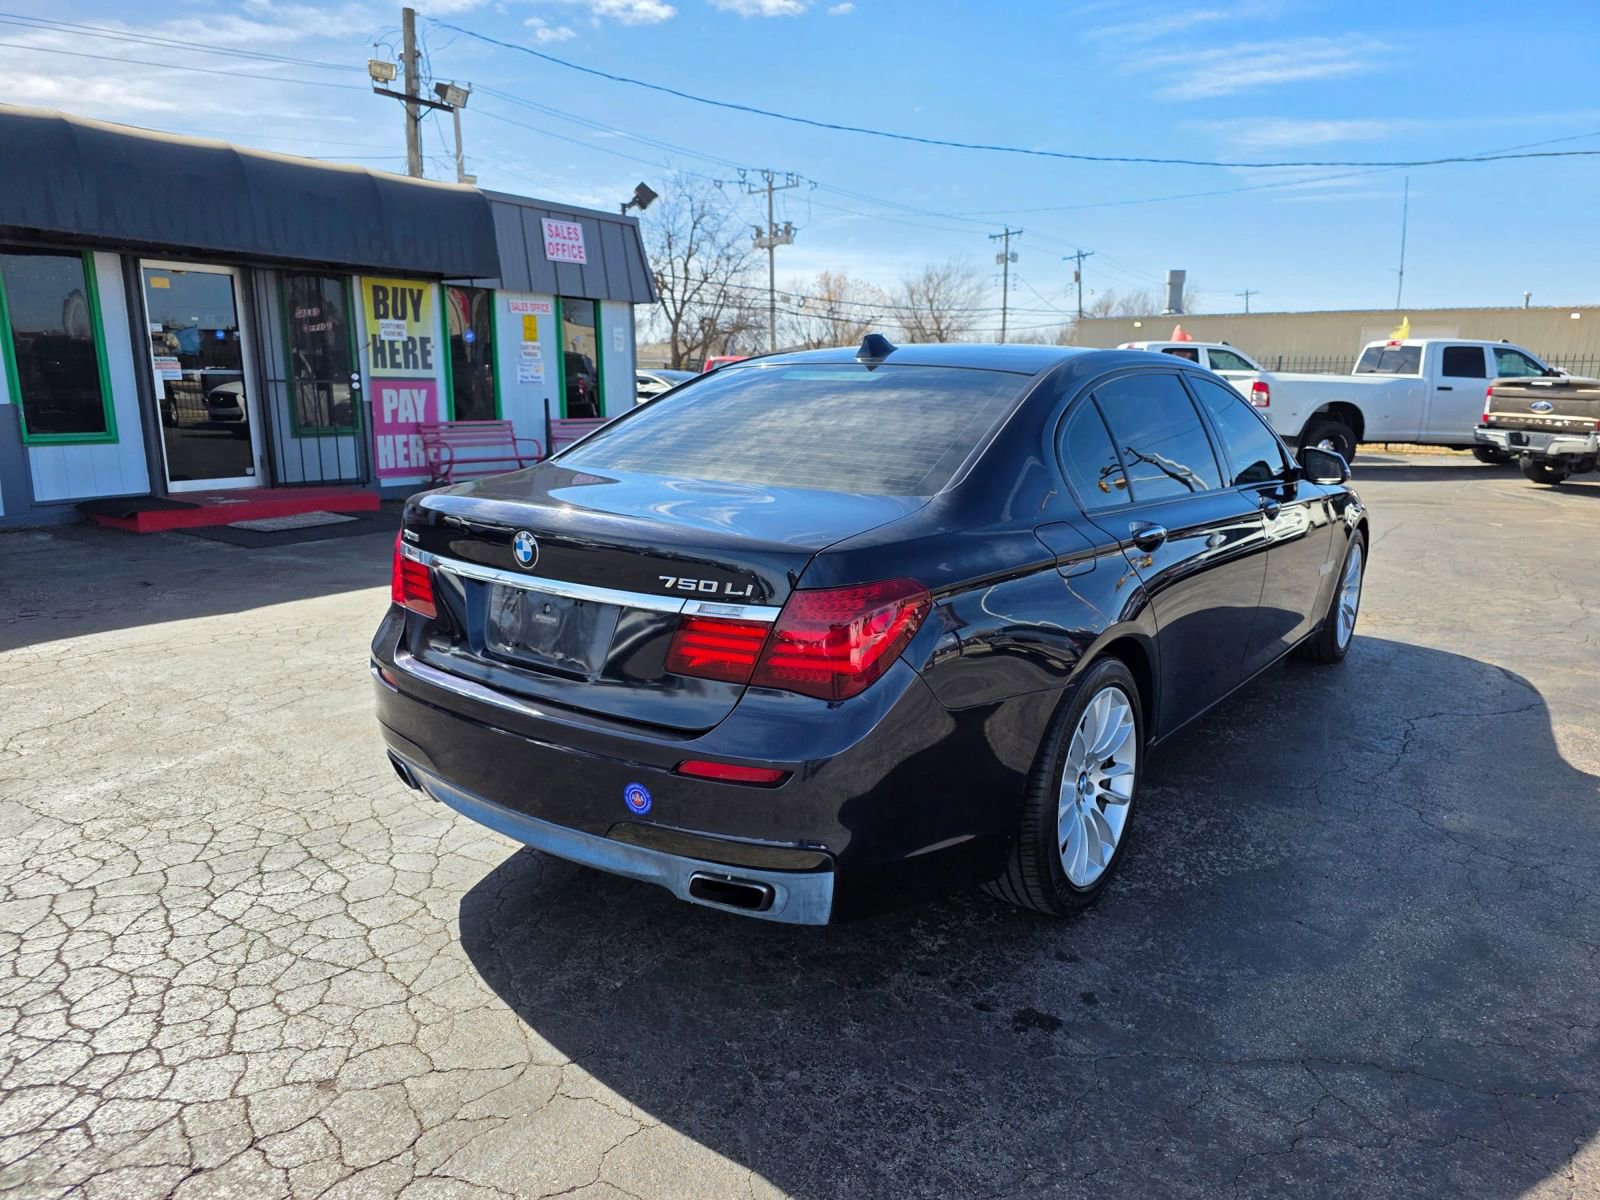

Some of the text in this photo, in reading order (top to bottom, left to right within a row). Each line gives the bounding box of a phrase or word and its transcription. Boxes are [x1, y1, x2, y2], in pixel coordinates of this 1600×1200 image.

[547, 223, 580, 241] SALES
[548, 242, 585, 260] OFFICE
[372, 284, 424, 323] BUY
[511, 301, 550, 313] SALES OFFICE
[371, 333, 433, 370] HERE
[382, 388, 428, 423] PAY
[377, 434, 439, 469] HERE
[658, 575, 719, 594] 750
